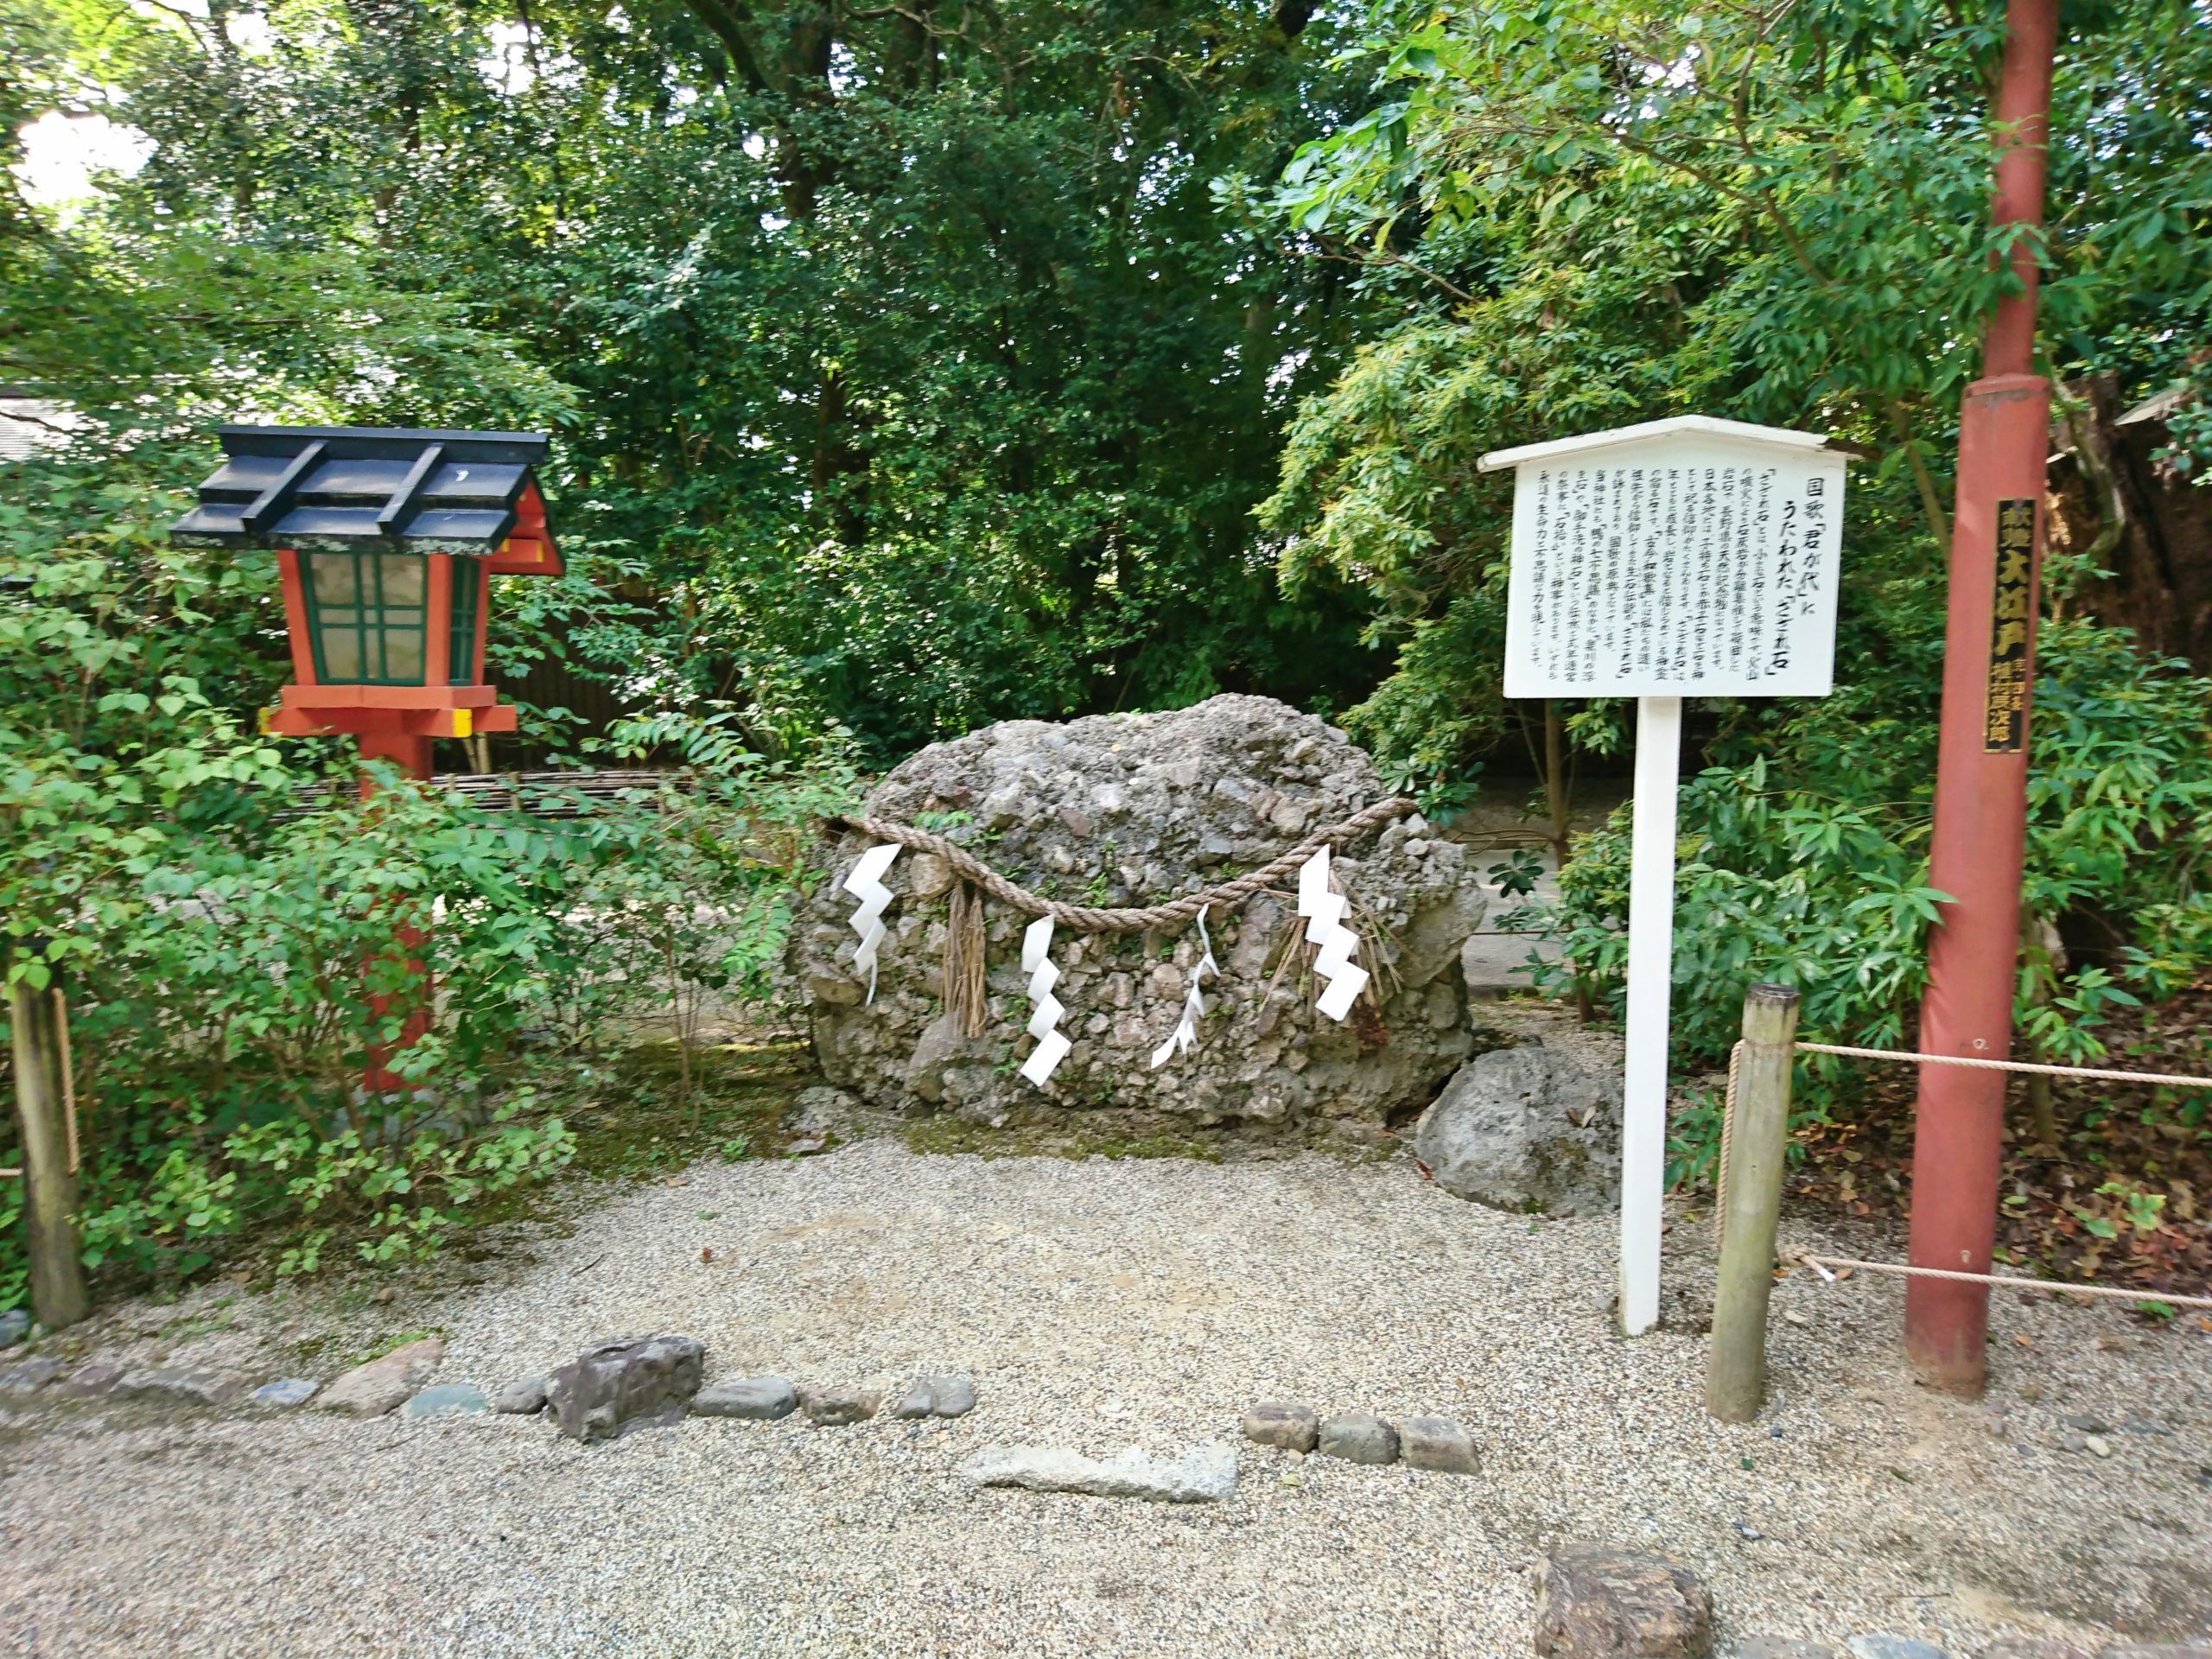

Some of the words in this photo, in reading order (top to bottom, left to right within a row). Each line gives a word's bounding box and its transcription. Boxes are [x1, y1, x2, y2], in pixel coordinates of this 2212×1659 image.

[1764, 499, 1797, 676] うたわれた「さざれ石」
[1796, 477, 1827, 615] 国歌「君が代」に
